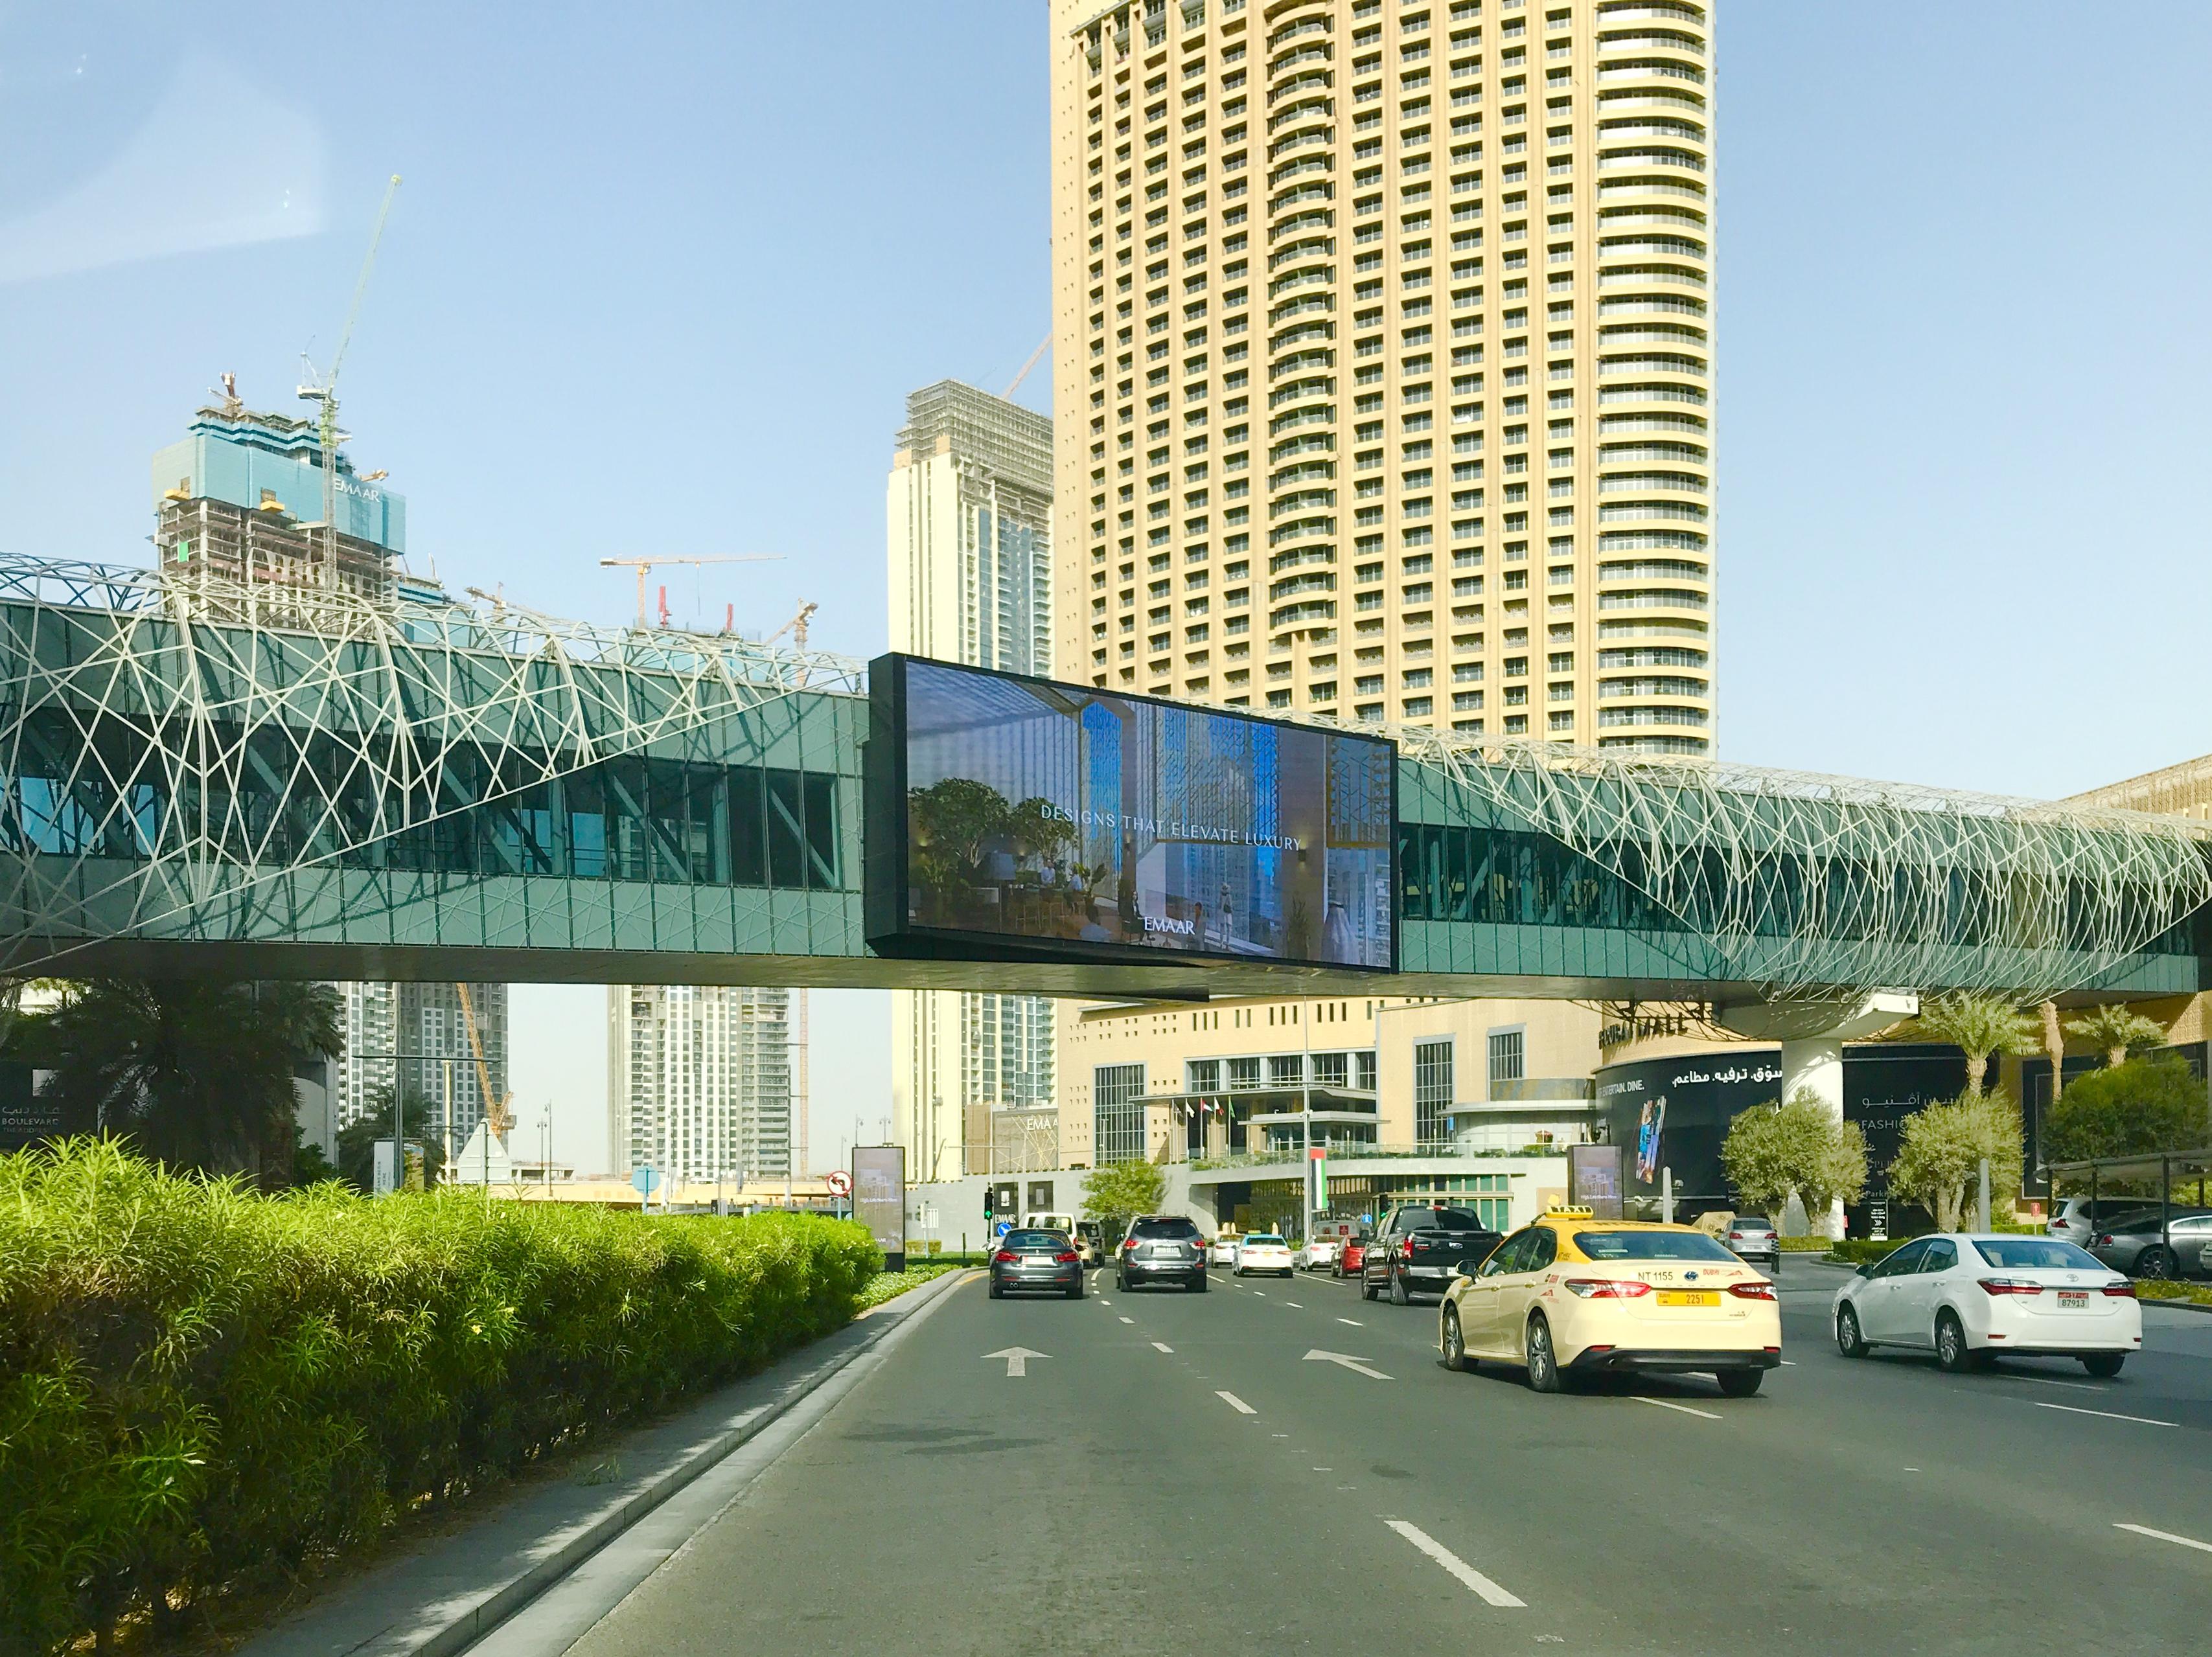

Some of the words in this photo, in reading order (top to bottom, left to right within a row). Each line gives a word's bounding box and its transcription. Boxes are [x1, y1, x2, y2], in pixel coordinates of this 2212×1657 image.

[334, 477, 380, 503] EMAAR
[1041, 805, 1116, 827] DESIGNS
[1123, 816, 1164, 833] THAT
[1171, 822, 1239, 843] ELEVATE
[1245, 832, 1302, 851] LUXURY
[1144, 916, 1195, 935] EMAAR
[1672, 1070, 1711, 1088] مطاعم.
[1750, 1064, 1782, 1082] سوّق.
[1627, 1079, 1645, 1092] DINE.
[1027, 1117, 1058, 1130] EMAA
[1638, 1272, 1651, 1281] NT
[1653, 1272, 1673, 1281] 1155
[1686, 1294, 1704, 1304] 2251
[2062, 1299, 2085, 1307] 87913
